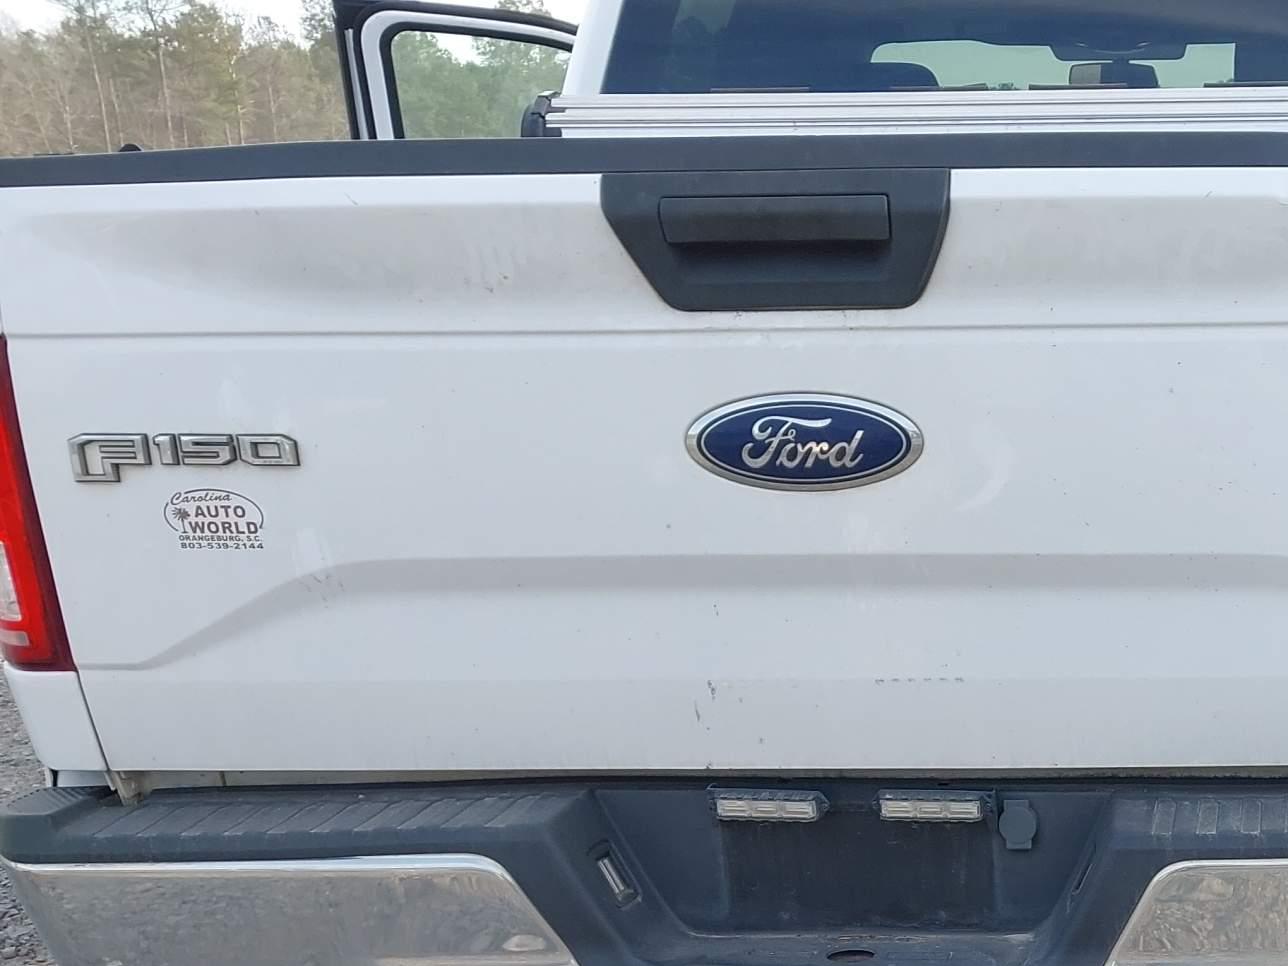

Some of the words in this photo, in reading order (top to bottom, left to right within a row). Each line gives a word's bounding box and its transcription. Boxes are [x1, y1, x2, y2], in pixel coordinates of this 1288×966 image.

[741, 415, 864, 469] Ford
[67, 433, 301, 482] F150
[170, 491, 233, 506] Carolina
[194, 505, 246, 519] AUTO
[188, 521, 259, 535] WORLD
[178, 535, 244, 543] ORANGEBURG,
[246, 535, 263, 543] S.C.
[180, 542, 264, 550] 803-539-2144
